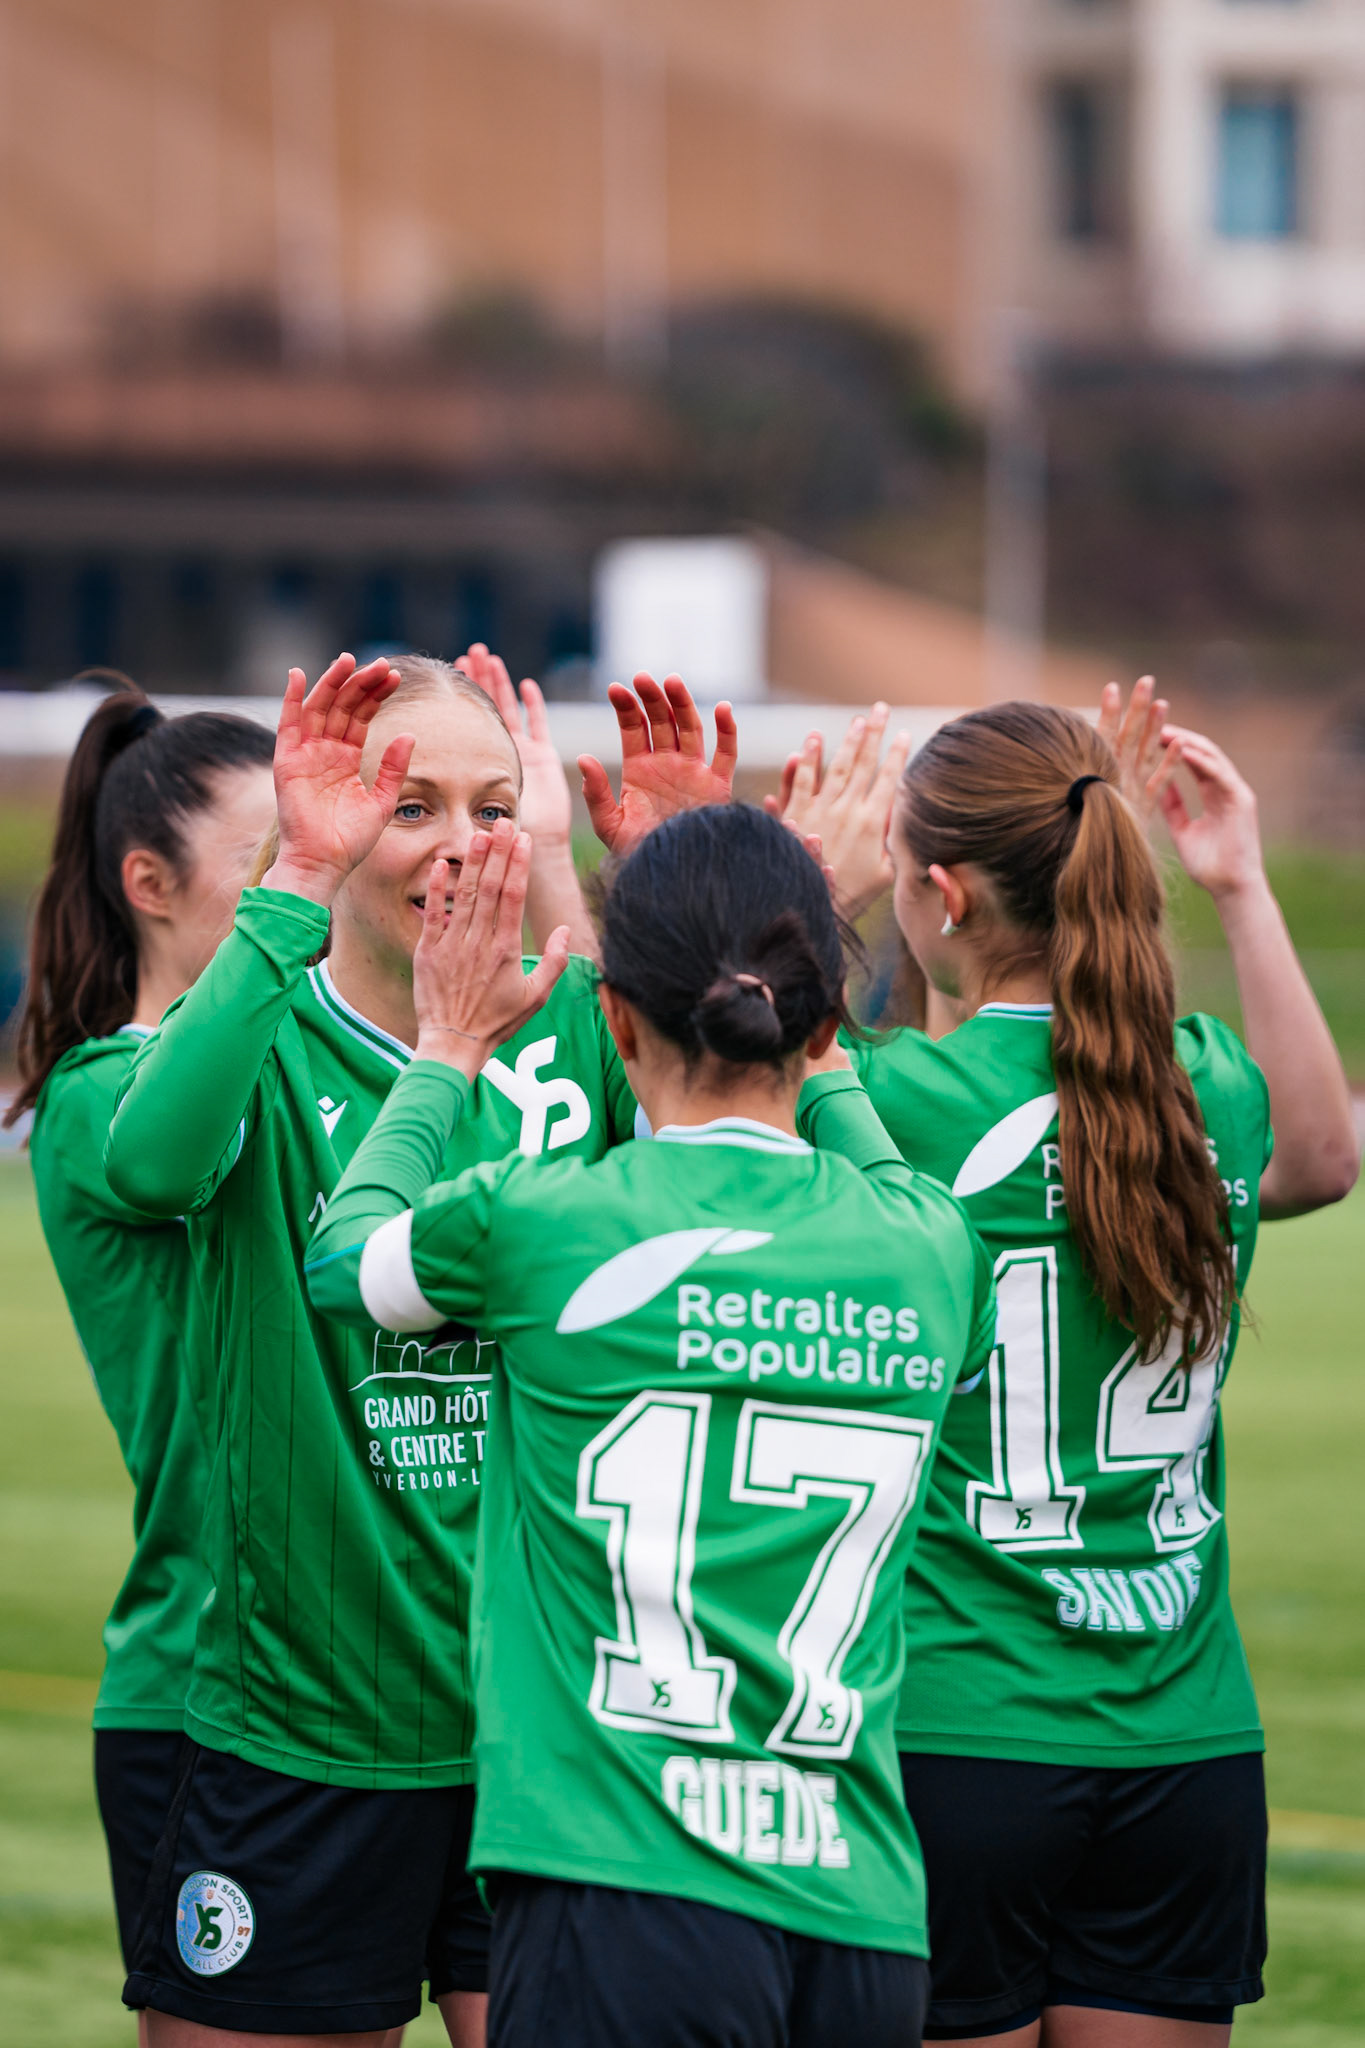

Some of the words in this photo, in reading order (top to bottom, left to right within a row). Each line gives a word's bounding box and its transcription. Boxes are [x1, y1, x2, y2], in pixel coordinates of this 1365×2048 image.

[677, 1283, 920, 1343] Retraites
[677, 1329, 946, 1392] Populaires
[364, 1394, 437, 1429] GRAND
[444, 1385, 491, 1424] HÔT
[966, 1245, 1238, 1554] 14
[368, 1440, 385, 1467] &
[390, 1432, 467, 1467] CENTRE
[471, 1430, 487, 1461] T
[372, 1468, 481, 1491] YVERDON-L
[576, 1390, 934, 1760] 17
[661, 1755, 850, 1869] GUEDE
[220, 1884, 249, 1920] SPORT
[237, 1926, 251, 1937] 97
[217, 1941, 244, 1967] CLUB
